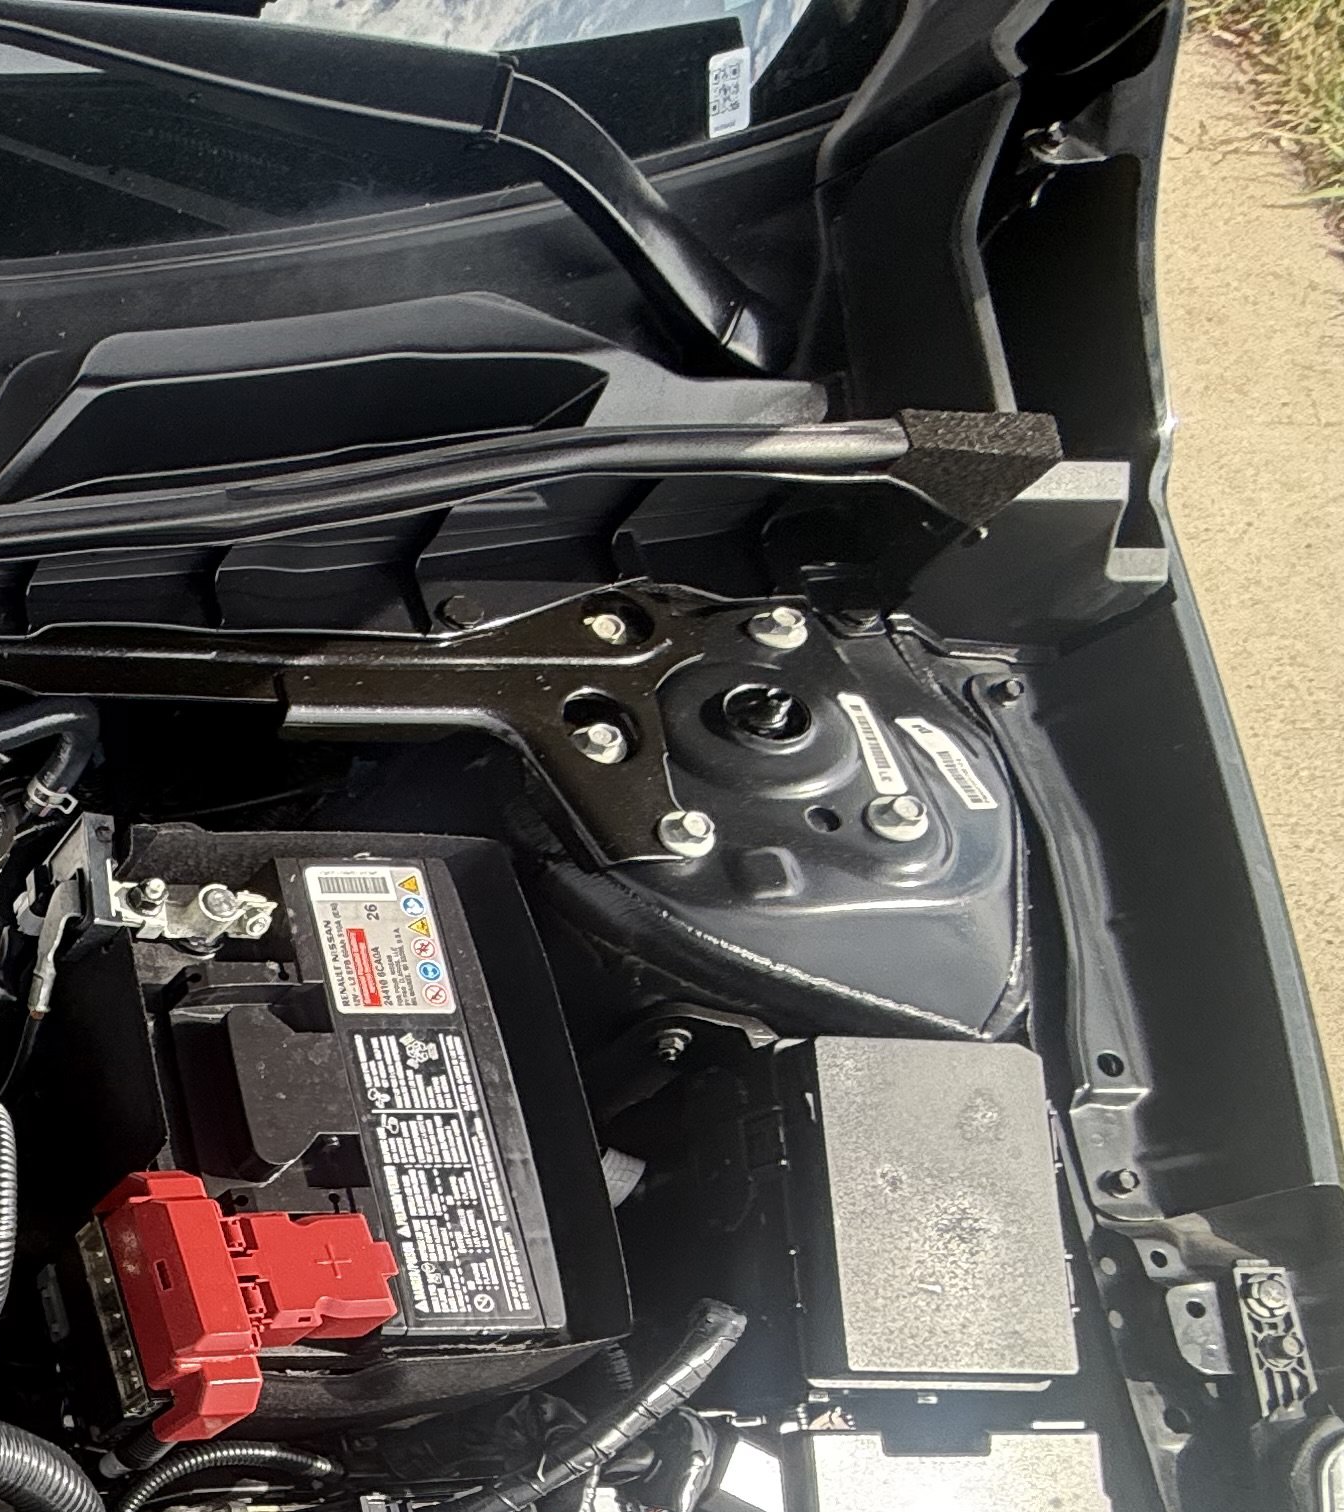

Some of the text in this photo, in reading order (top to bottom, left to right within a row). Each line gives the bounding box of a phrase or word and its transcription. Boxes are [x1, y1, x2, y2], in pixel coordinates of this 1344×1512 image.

[364, 904, 380, 920] 26
[322, 920, 350, 1006] RENAULT NISSAN
